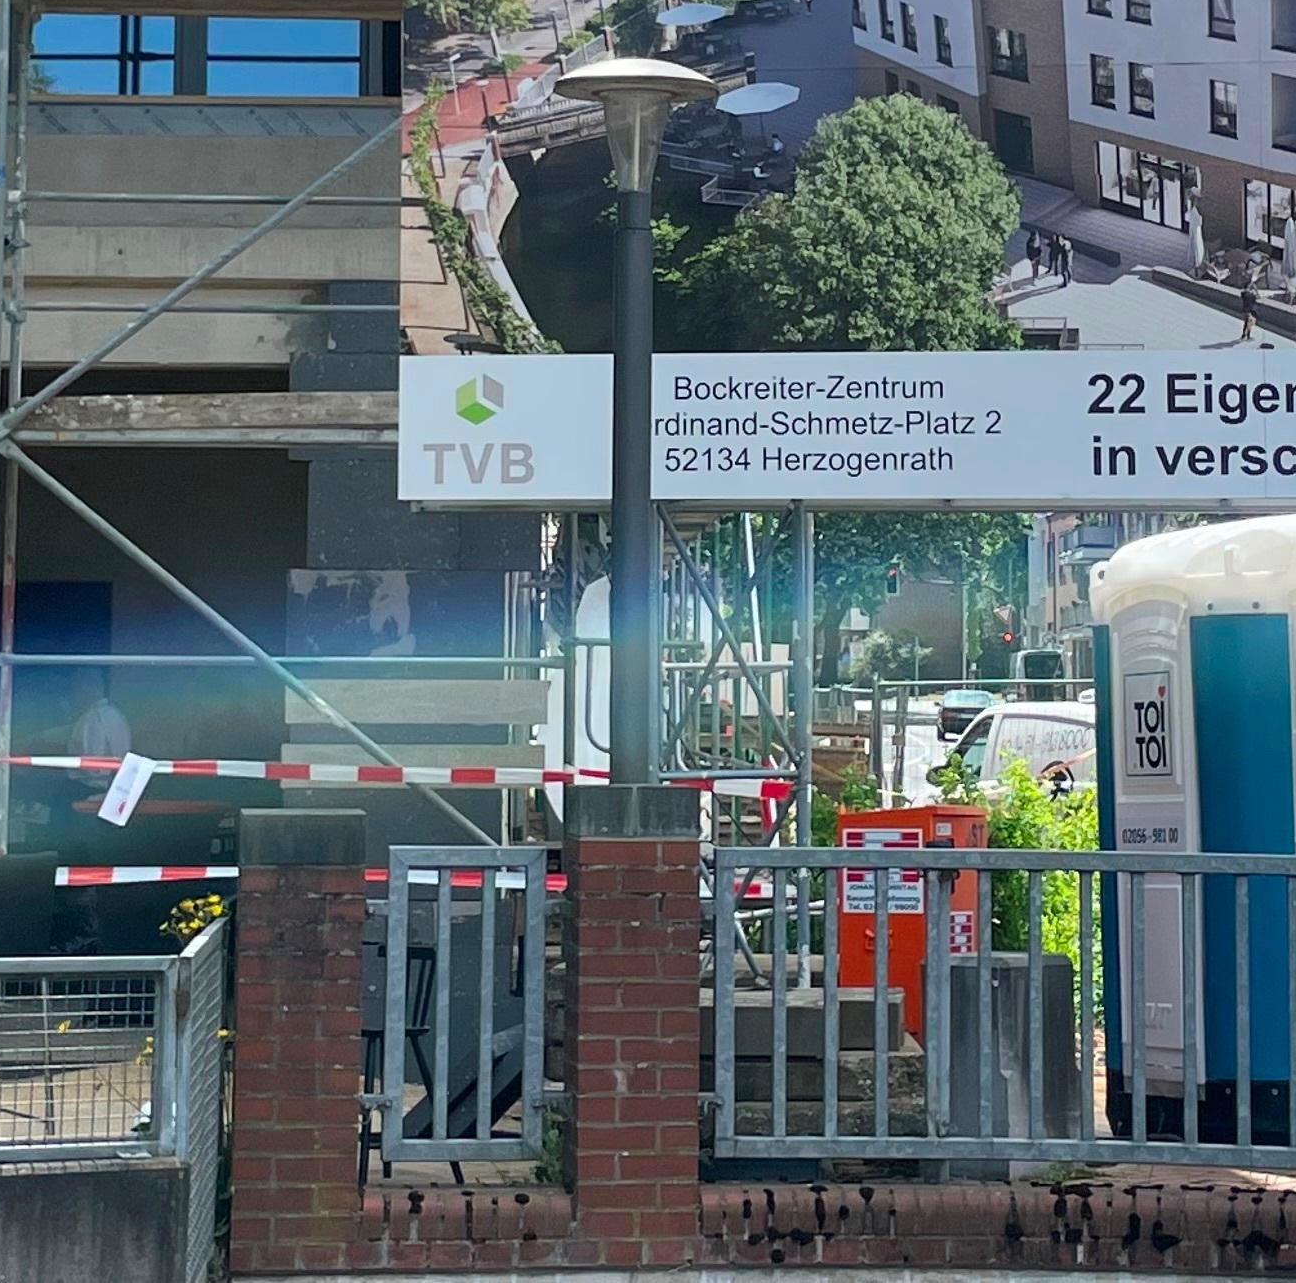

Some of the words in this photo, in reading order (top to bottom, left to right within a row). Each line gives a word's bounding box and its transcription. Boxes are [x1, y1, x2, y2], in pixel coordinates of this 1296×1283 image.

[673, 375, 944, 401] Bockreiter-Zentrum
[1087, 373, 1146, 415] 22
[654, 410, 974, 437] rdinand-Schmetz-Platz
[985, 410, 1003, 435] 2
[423, 443, 535, 485] TVB
[664, 448, 750, 473] 52134
[761, 448, 954, 477] Herzogenrath
[1092, 435, 1137, 475] in
[1134, 701, 1166, 734] TOI
[1135, 735, 1167, 769] TOI
[1121, 828, 1147, 844] 02056
